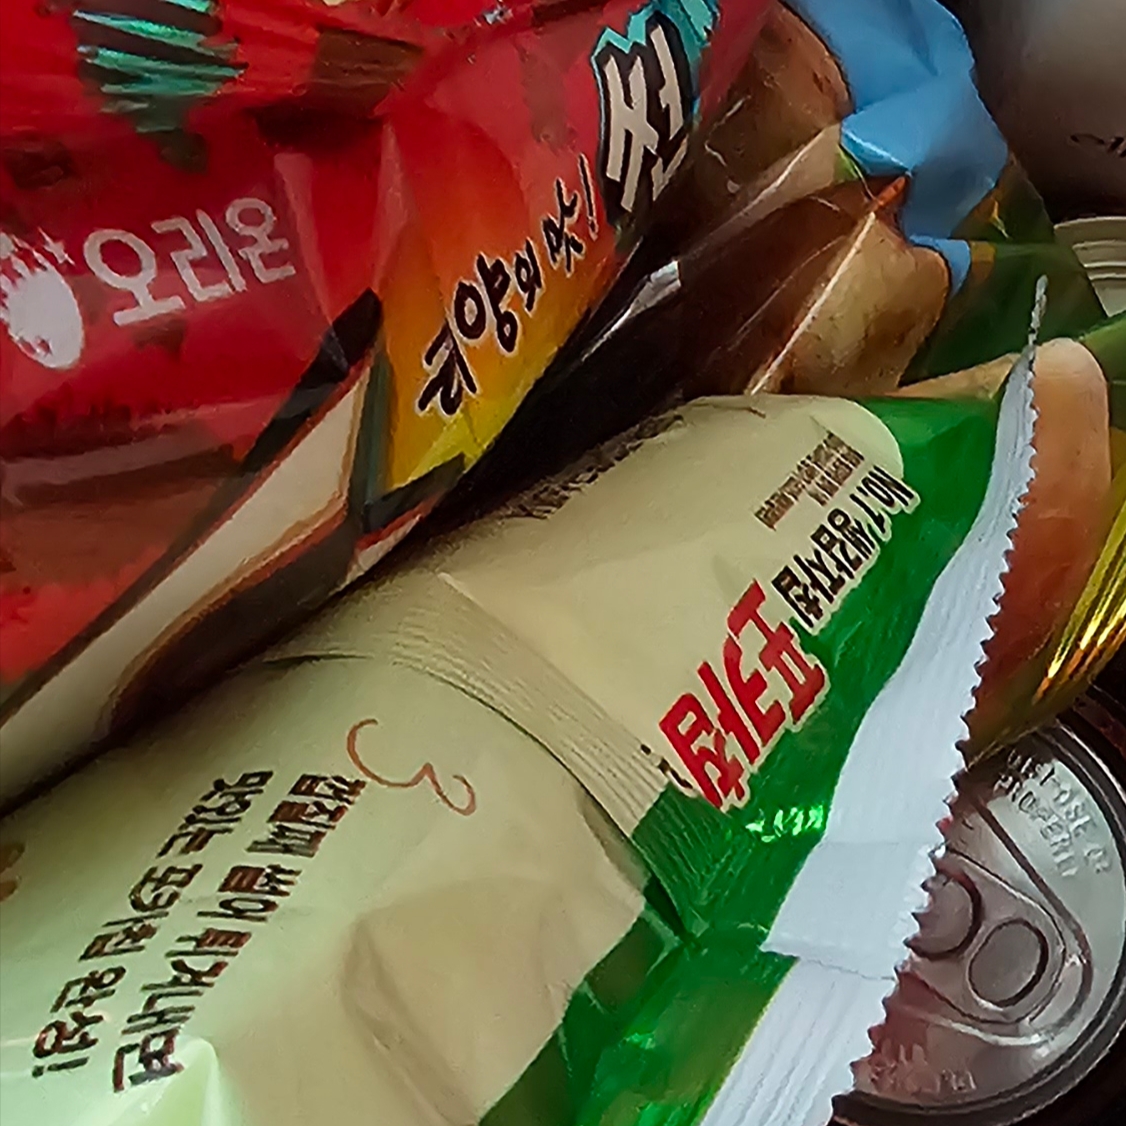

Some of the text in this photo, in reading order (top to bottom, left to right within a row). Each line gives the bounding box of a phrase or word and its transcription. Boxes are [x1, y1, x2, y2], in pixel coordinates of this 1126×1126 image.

[83, 197, 296, 327] 오리온
[770, 507, 876, 628] 생감자칩
[658, 579, 826, 810] 포카칩
[31, 769, 275, 1078] 맛있는 포카칩 완성!
[197, 863, 302, 924] 썰어
